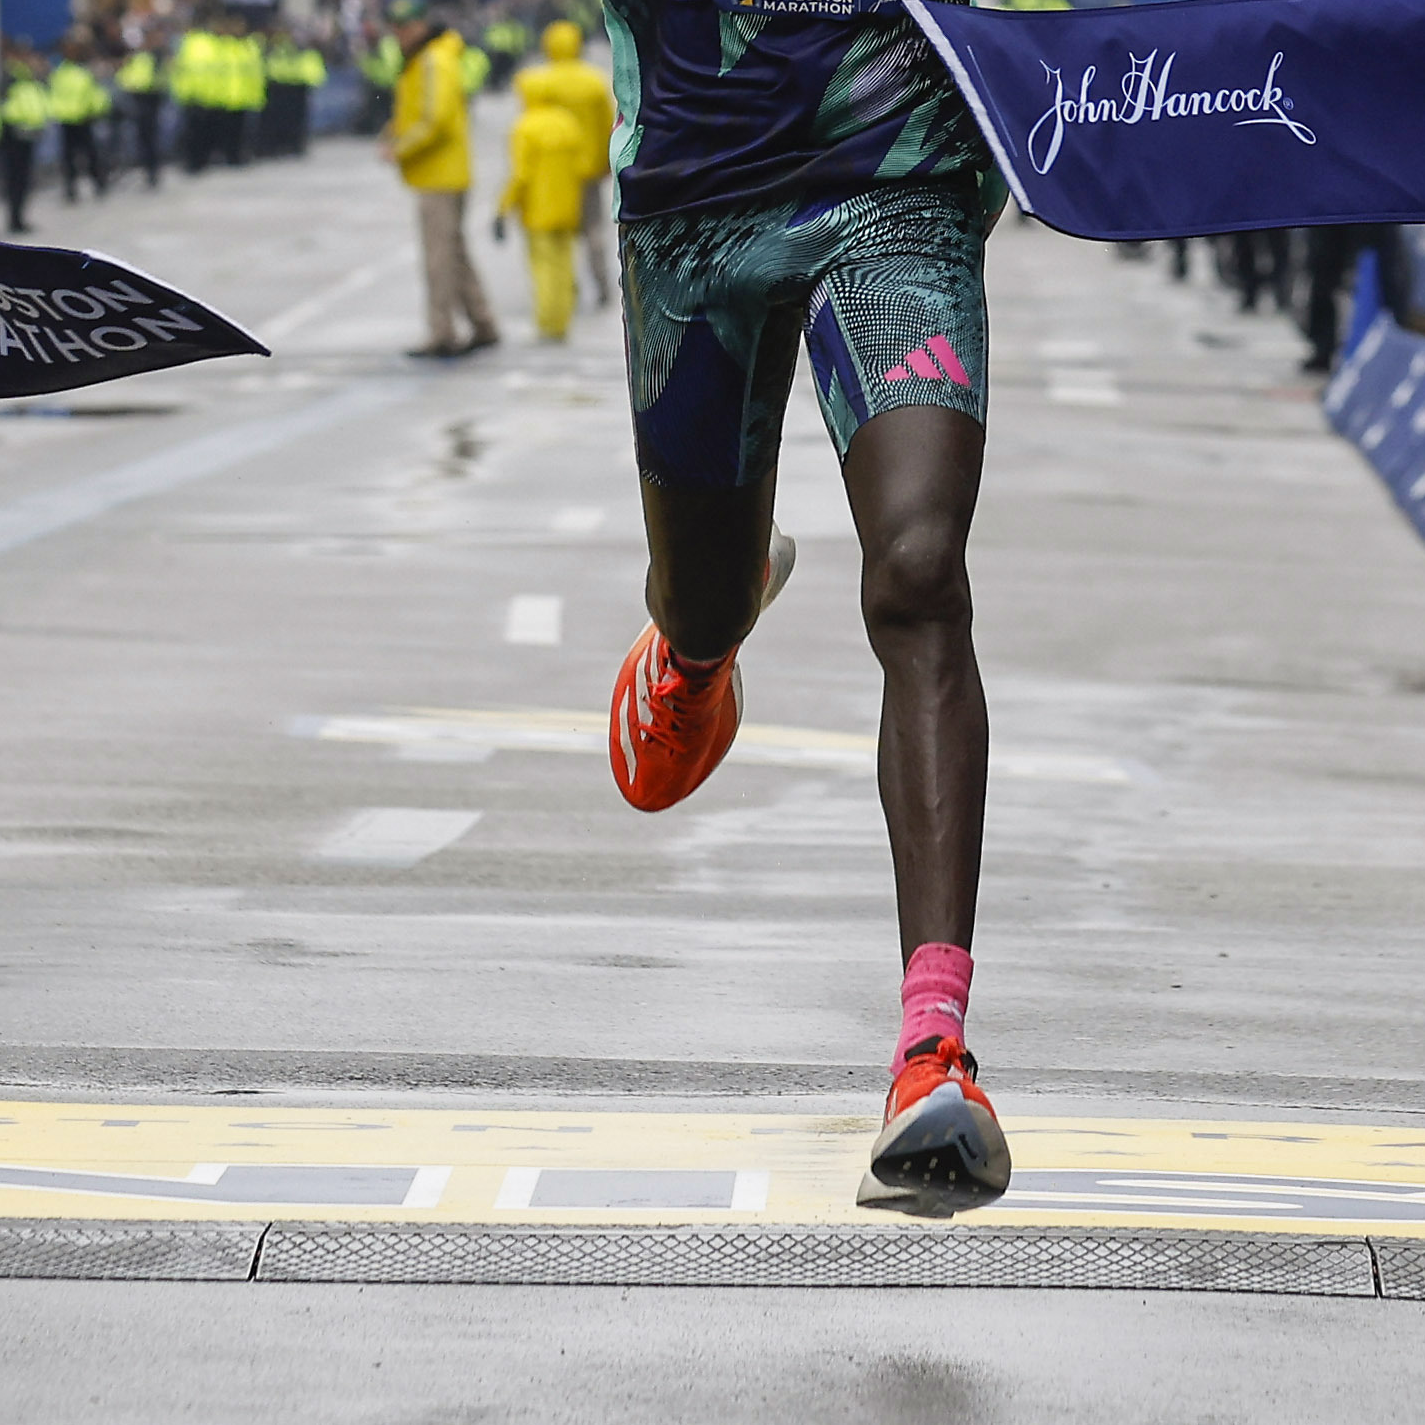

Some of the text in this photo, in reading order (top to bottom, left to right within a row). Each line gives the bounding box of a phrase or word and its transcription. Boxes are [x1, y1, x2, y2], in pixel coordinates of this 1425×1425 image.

[763, 0, 853, 14] MARATHON
[1027, 49, 1317, 175] John Hancock
